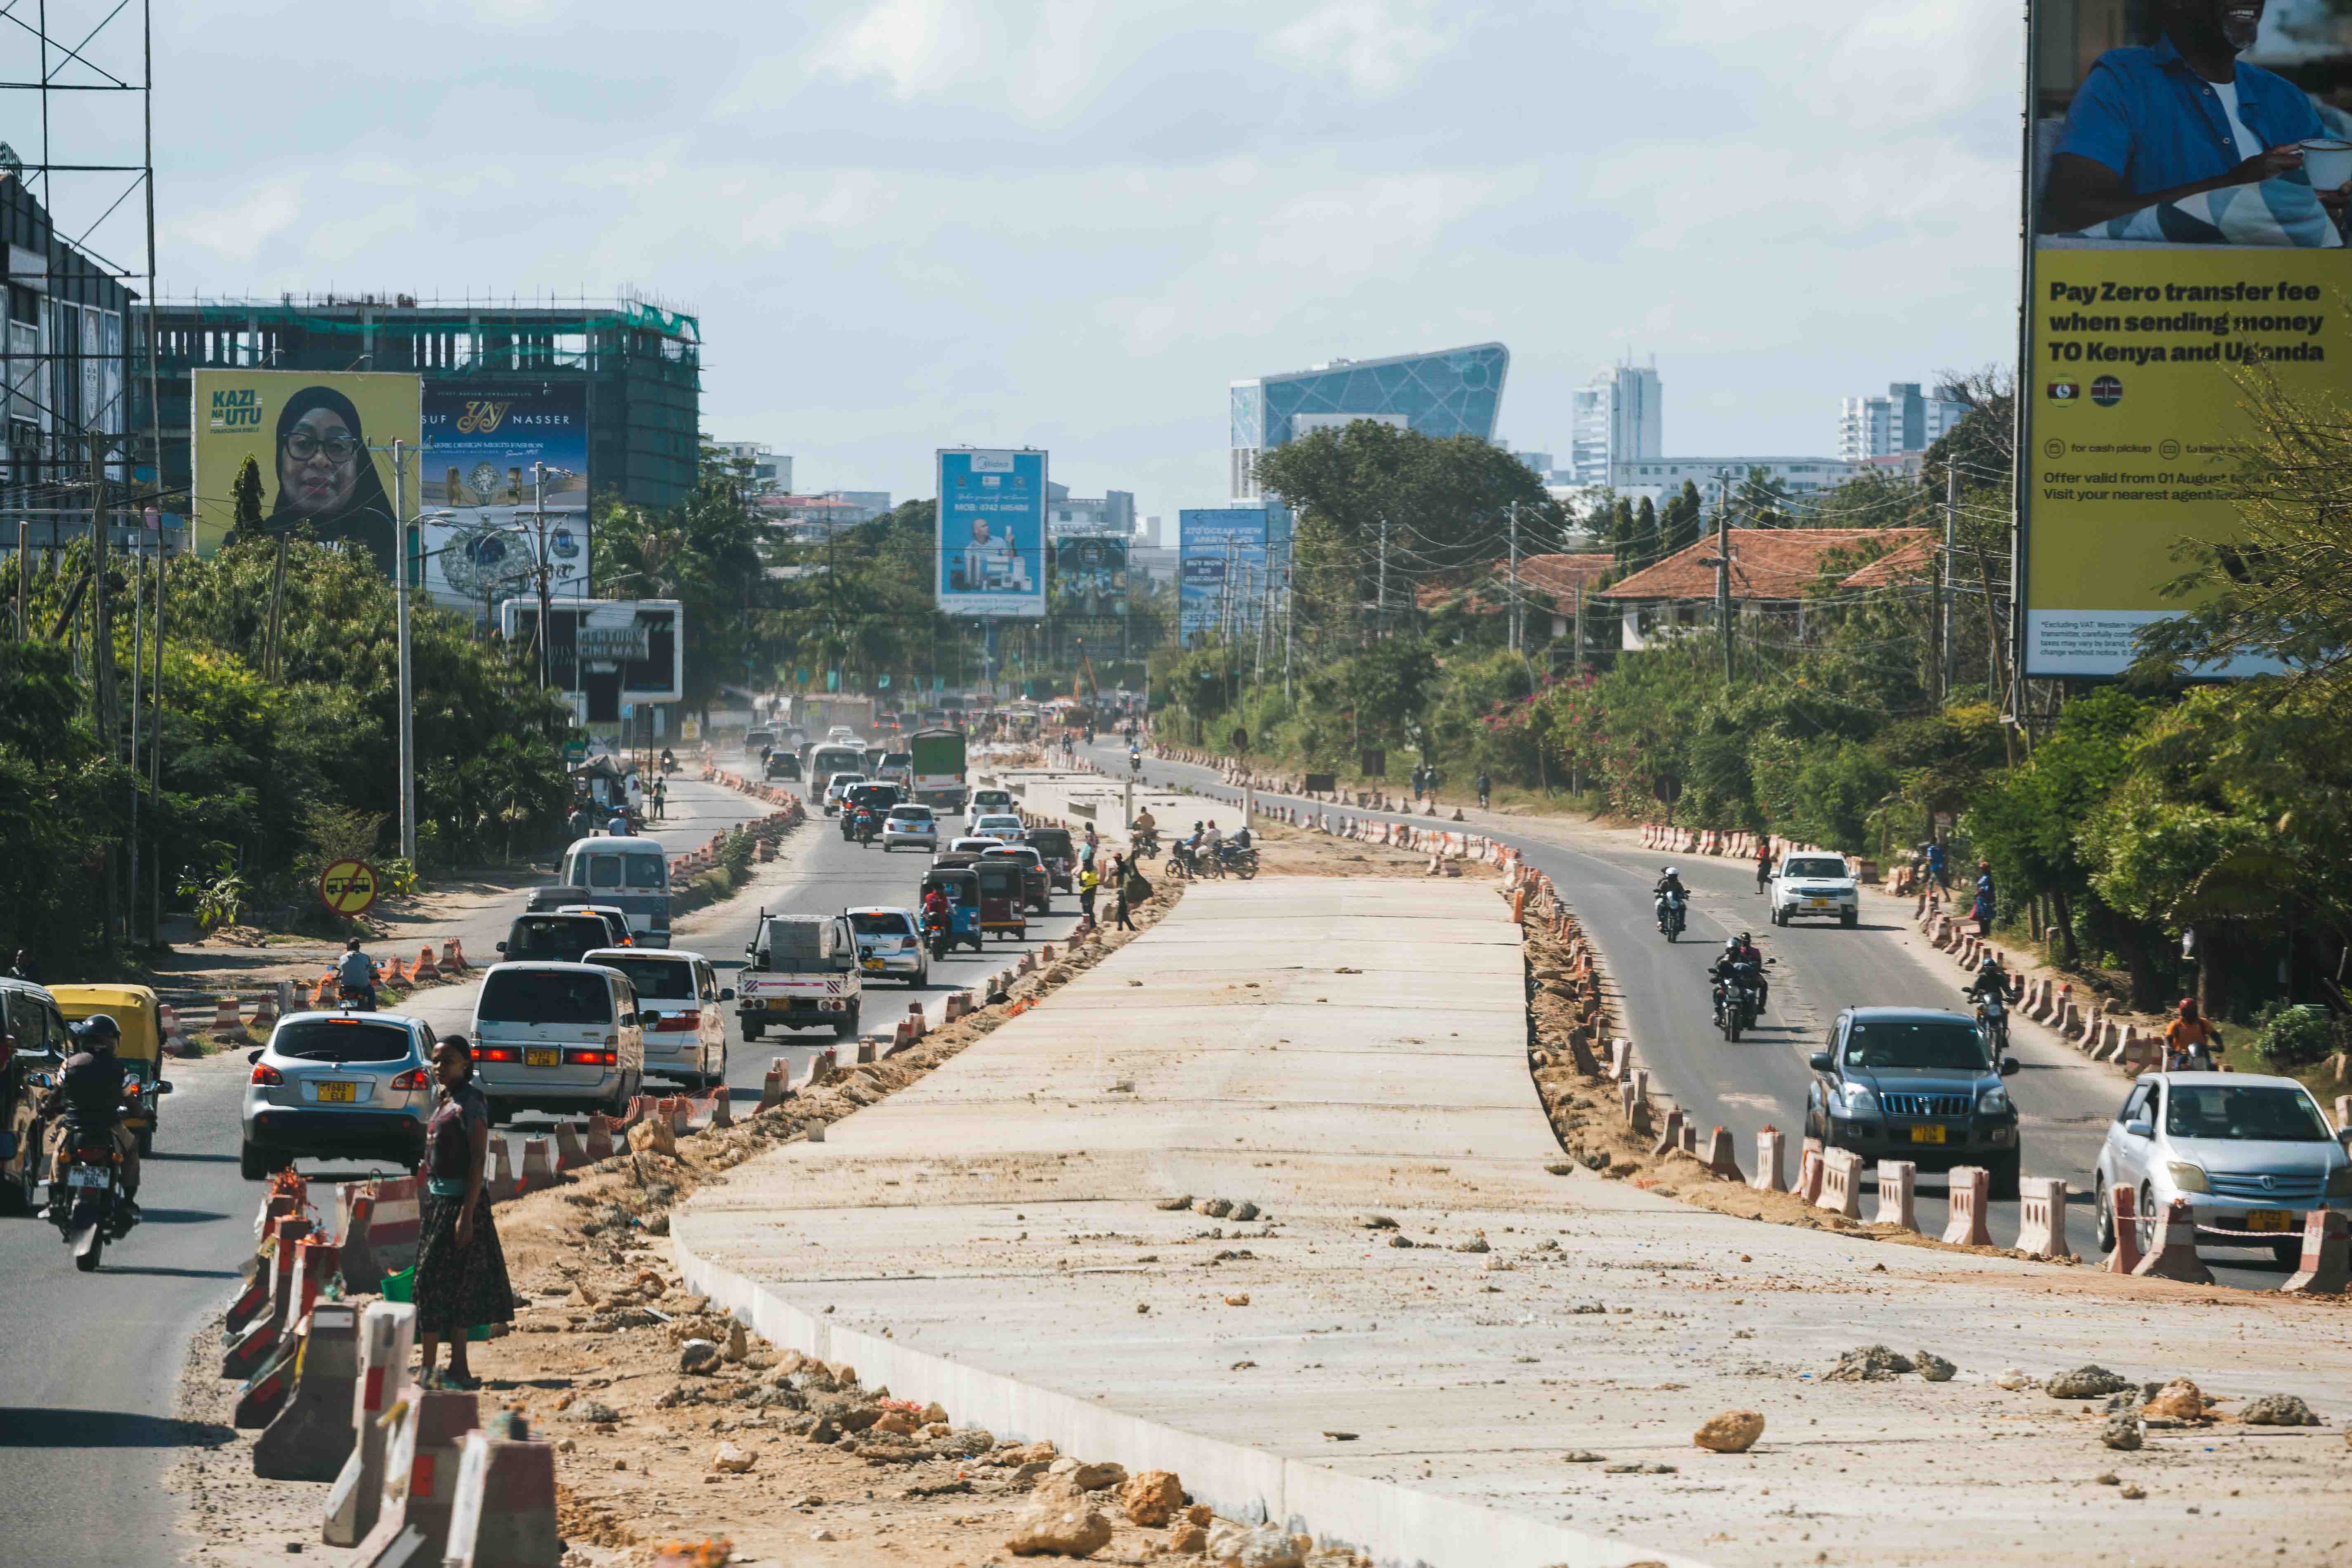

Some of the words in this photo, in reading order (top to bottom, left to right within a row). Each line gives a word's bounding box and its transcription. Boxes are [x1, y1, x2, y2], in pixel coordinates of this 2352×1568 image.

[2050, 282, 2097, 306] Pay
[2100, 282, 2161, 302] Zero
[2164, 282, 2273, 302] transfer
[2277, 281, 2321, 302] fee
[2049, 312, 2121, 331] when
[2124, 312, 2230, 336] sending
[2233, 315, 2324, 335] money
[2049, 342, 2082, 361] TO
[2085, 342, 2166, 366] Kenya
[2170, 342, 2220, 361] and
[2225, 342, 2324, 365] Uganda
[212, 389, 255, 407] KAZI
[211, 409, 224, 418] NA
[225, 408, 262, 425] UTU
[512, 415, 570, 424] NASSER
[2071, 444, 2086, 453] for
[2089, 444, 2115, 453] cash
[2116, 444, 2152, 454] pickup
[2043, 472, 2081, 483] Offer
[2085, 472, 2117, 483] valid
[2121, 472, 2154, 483] from
[2177, 473, 2227, 486] August
[2043, 489, 2074, 500] Visit
[2076, 491, 2110, 502] your
[2112, 490, 2169, 500] nearest
[2171, 489, 2212, 502] agent
